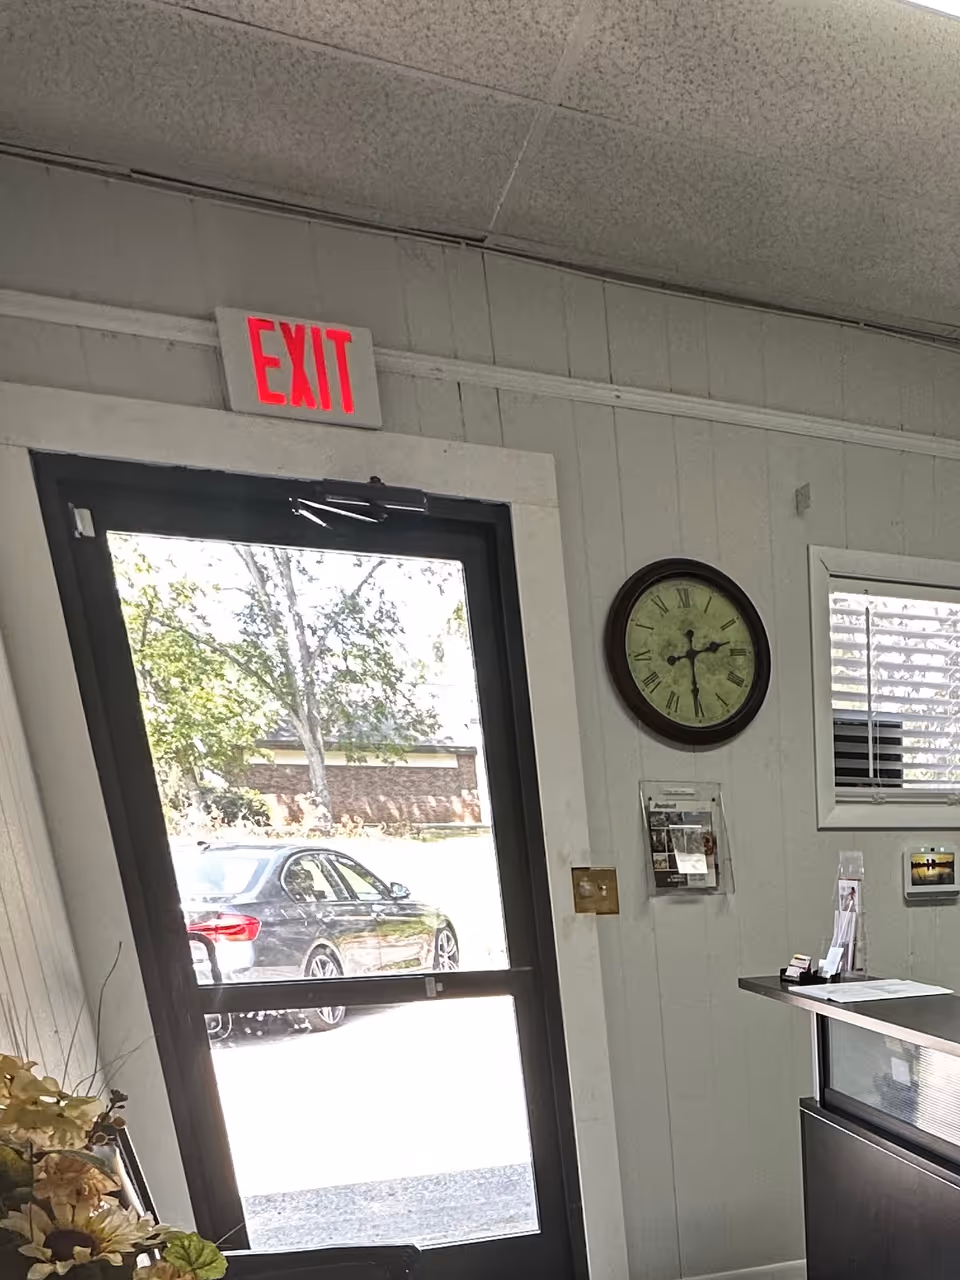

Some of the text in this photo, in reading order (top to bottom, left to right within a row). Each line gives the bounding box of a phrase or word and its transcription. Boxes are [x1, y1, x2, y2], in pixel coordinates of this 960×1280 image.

[247, 316, 354, 414] EXIT
[676, 587, 691, 609] XII
[720, 618, 737, 631] II
[729, 648, 747, 657] III
